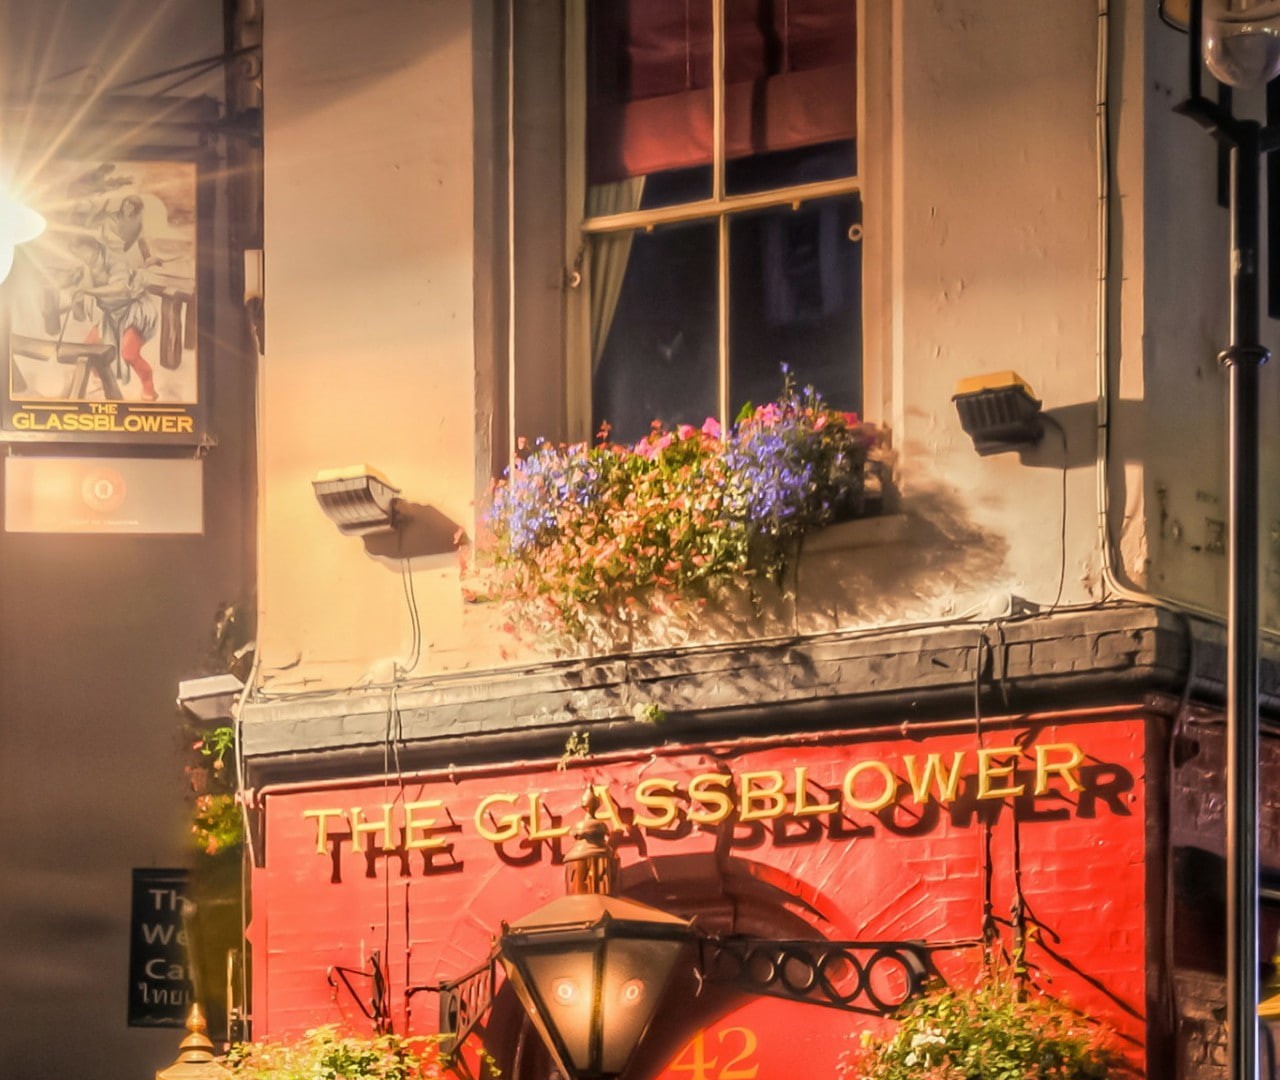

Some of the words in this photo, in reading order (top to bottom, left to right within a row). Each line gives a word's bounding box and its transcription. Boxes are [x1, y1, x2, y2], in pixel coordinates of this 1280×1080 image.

[89, 403, 119, 415] THE
[12, 412, 194, 433] GLASSBLOWER
[303, 799, 447, 855] THE
[474, 742, 1085, 843] GLASSBLOWER
[148, 888, 187, 911] Th
